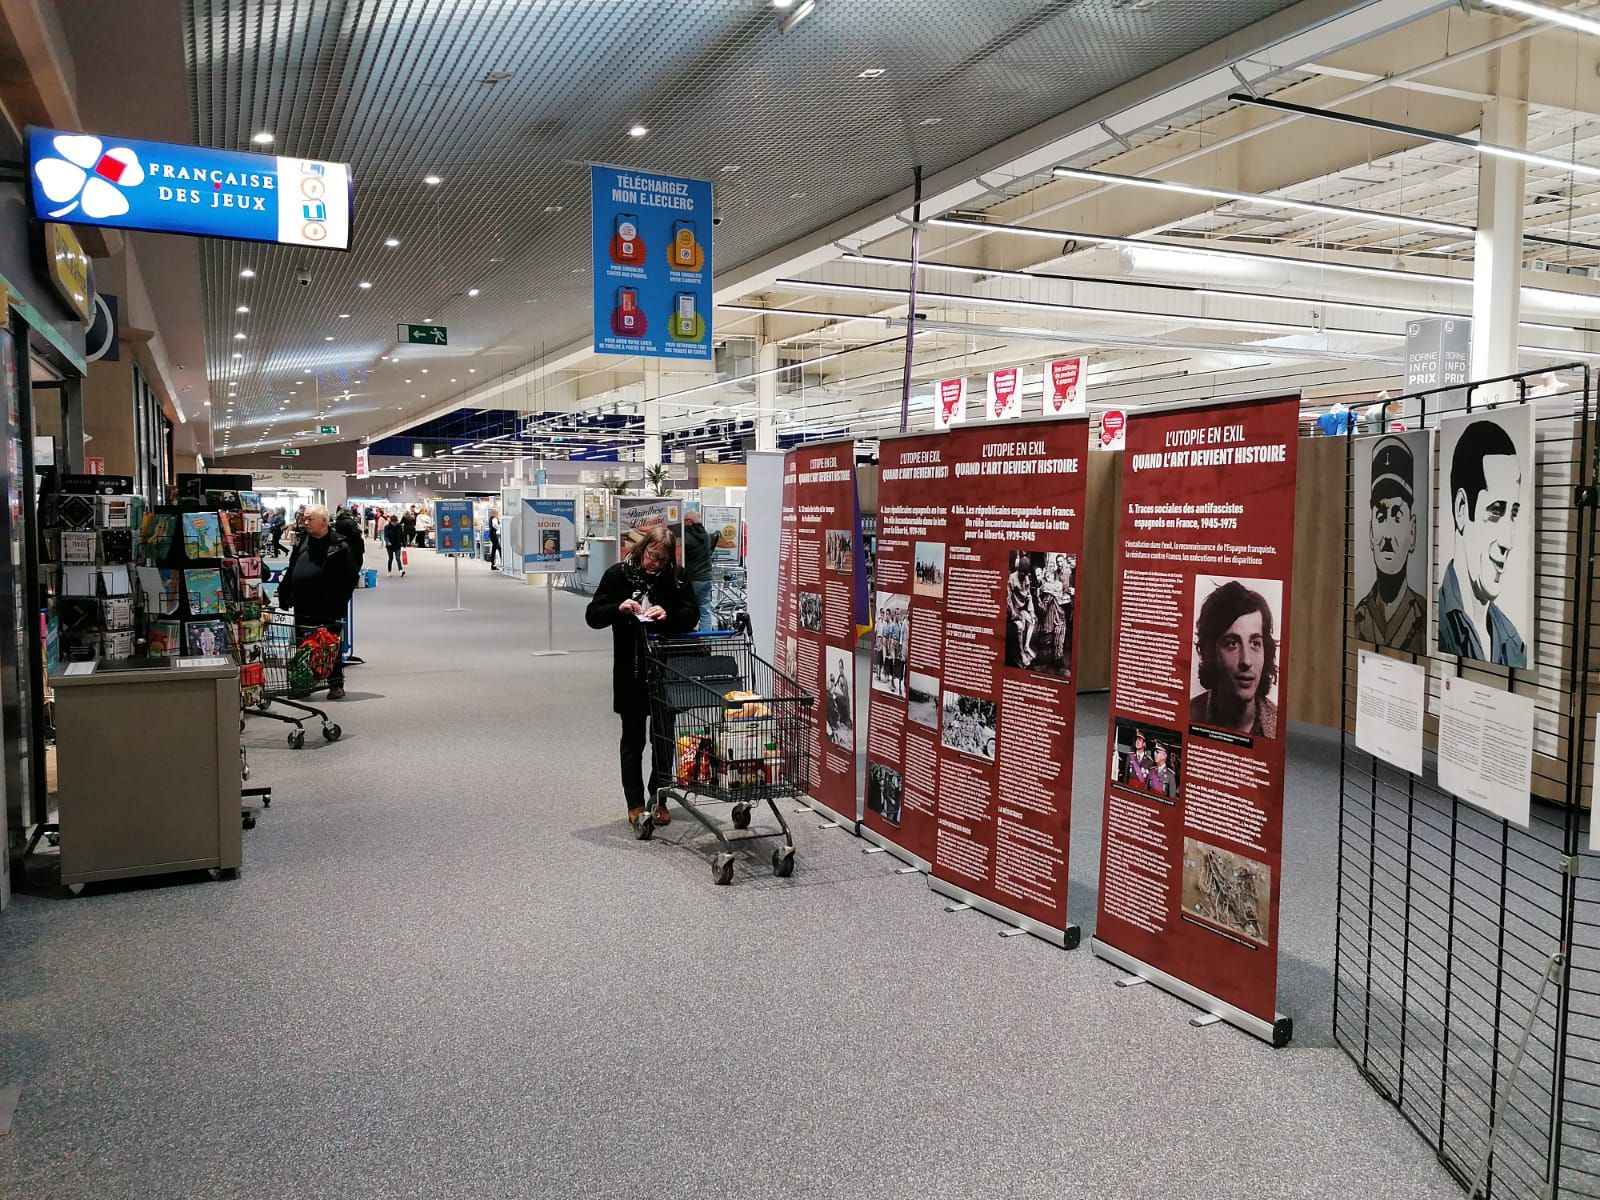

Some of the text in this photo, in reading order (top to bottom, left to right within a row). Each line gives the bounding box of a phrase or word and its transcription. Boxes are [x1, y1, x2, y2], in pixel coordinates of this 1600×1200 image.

[149, 163, 275, 189] FRANÇAISE
[617, 174, 689, 197] TÉLÉCHARGEZ
[159, 187, 266, 211] DES JEUX
[612, 189, 694, 211] MON E.LECLERC
[1409, 352, 1438, 362] BORNE
[1445, 352, 1466, 361] BORNE
[1410, 362, 1436, 373] INFO
[1445, 362, 1466, 372] INFO
[1409, 373, 1437, 385] PRIX
[1444, 372, 1465, 384] PRIX
[1166, 424, 1245, 448] L'UTOPIE EN EXIL
[982, 440, 1046, 458] L'UTOPIE EN EXIL
[900, 450, 940, 465] L'UTOPIE EN EXIL
[1132, 444, 1286, 472] QUAND L'ART DEVIENT HISTOIRE
[882, 468, 898, 482] QUAND
[899, 466, 913, 480] L'ART
[914, 466, 935, 480] DEVIENT
[955, 458, 1078, 478] QUAND L'ART DEVIENT HISTOIRE
[966, 507, 974, 515] Les
[975, 506, 1010, 516] républicains
[1010, 506, 1042, 518] espagnols
[1042, 508, 1050, 516] en
[1128, 502, 1244, 514] 5. Traces sociales des antifascistes
[984, 519, 1029, 530] incontournable
[1030, 520, 1045, 530] dans
[1046, 520, 1052, 529] la
[1053, 520, 1070, 530] lutte
[1134, 518, 1238, 530] espagnols en France, 1945-1975
[964, 530, 977, 540] pour
[977, 530, 984, 539] la
[984, 530, 1006, 541] liberté,
